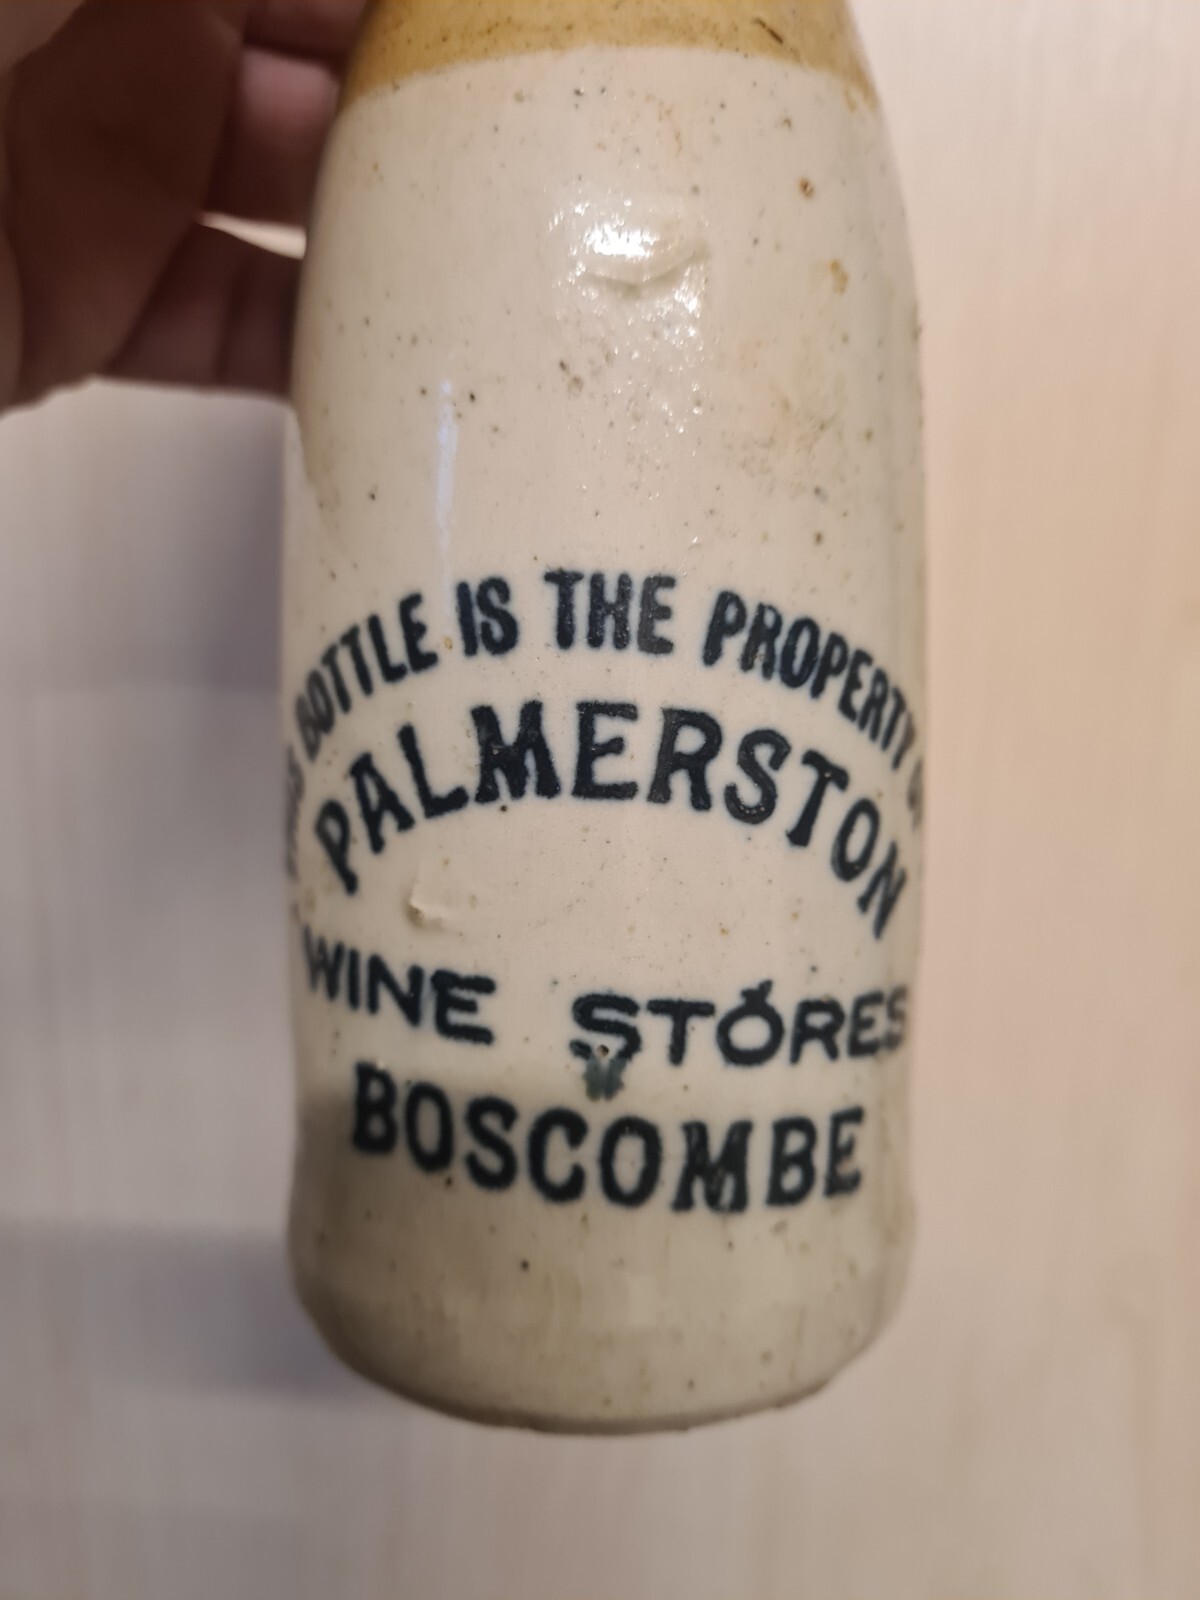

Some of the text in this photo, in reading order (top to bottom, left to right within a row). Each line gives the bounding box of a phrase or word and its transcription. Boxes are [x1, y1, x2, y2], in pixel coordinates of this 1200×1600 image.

[295, 570, 916, 772] BOTTLE IS THE PROPERTY
[315, 699, 907, 940] PALMERSTON
[302, 925, 496, 1046] WINE
[352, 1059, 864, 1214] BOSCOMBE
